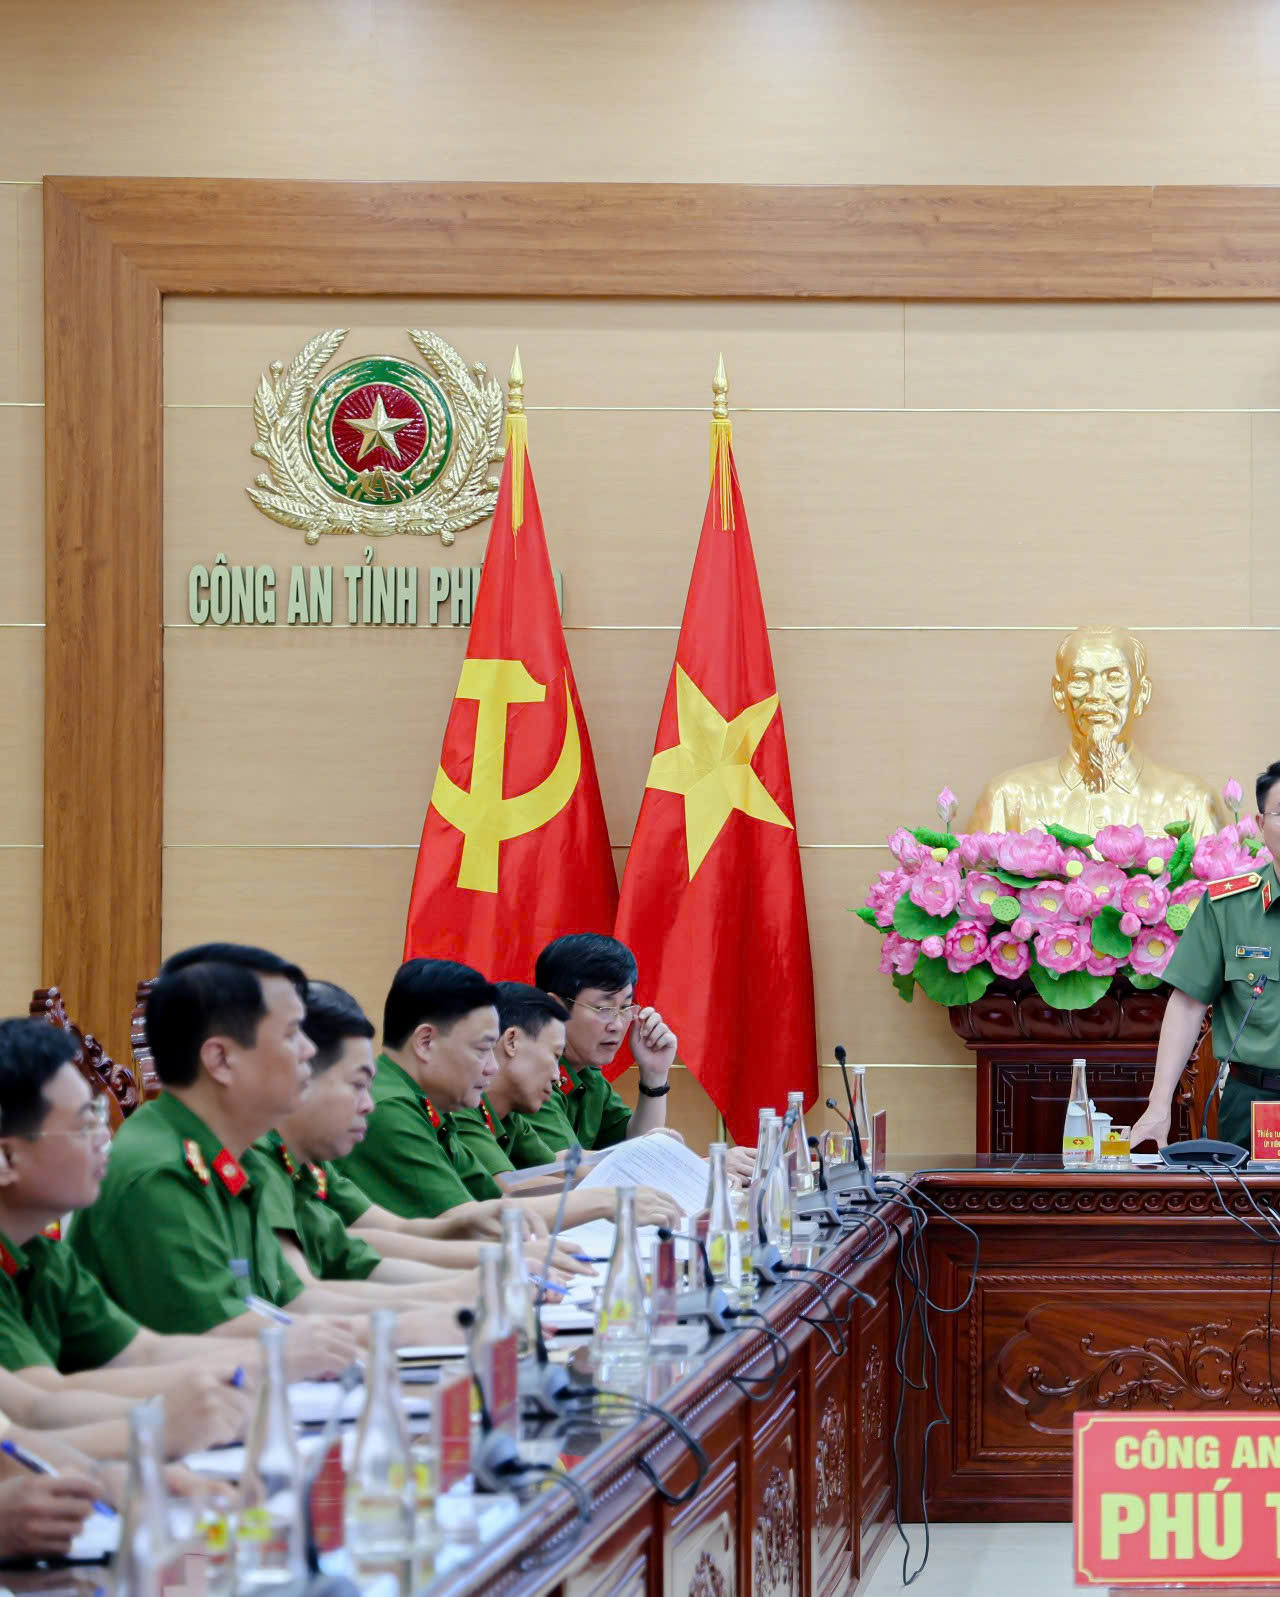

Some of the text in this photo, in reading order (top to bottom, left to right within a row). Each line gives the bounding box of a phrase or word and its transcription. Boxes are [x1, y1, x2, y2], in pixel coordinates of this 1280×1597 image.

[188, 553, 276, 625] CÔNG
[287, 566, 334, 625] AN
[343, 545, 413, 625] TỈNH
[1114, 1429, 1220, 1470] CÔNG
[1100, 1477, 1243, 1561] PHÚ
